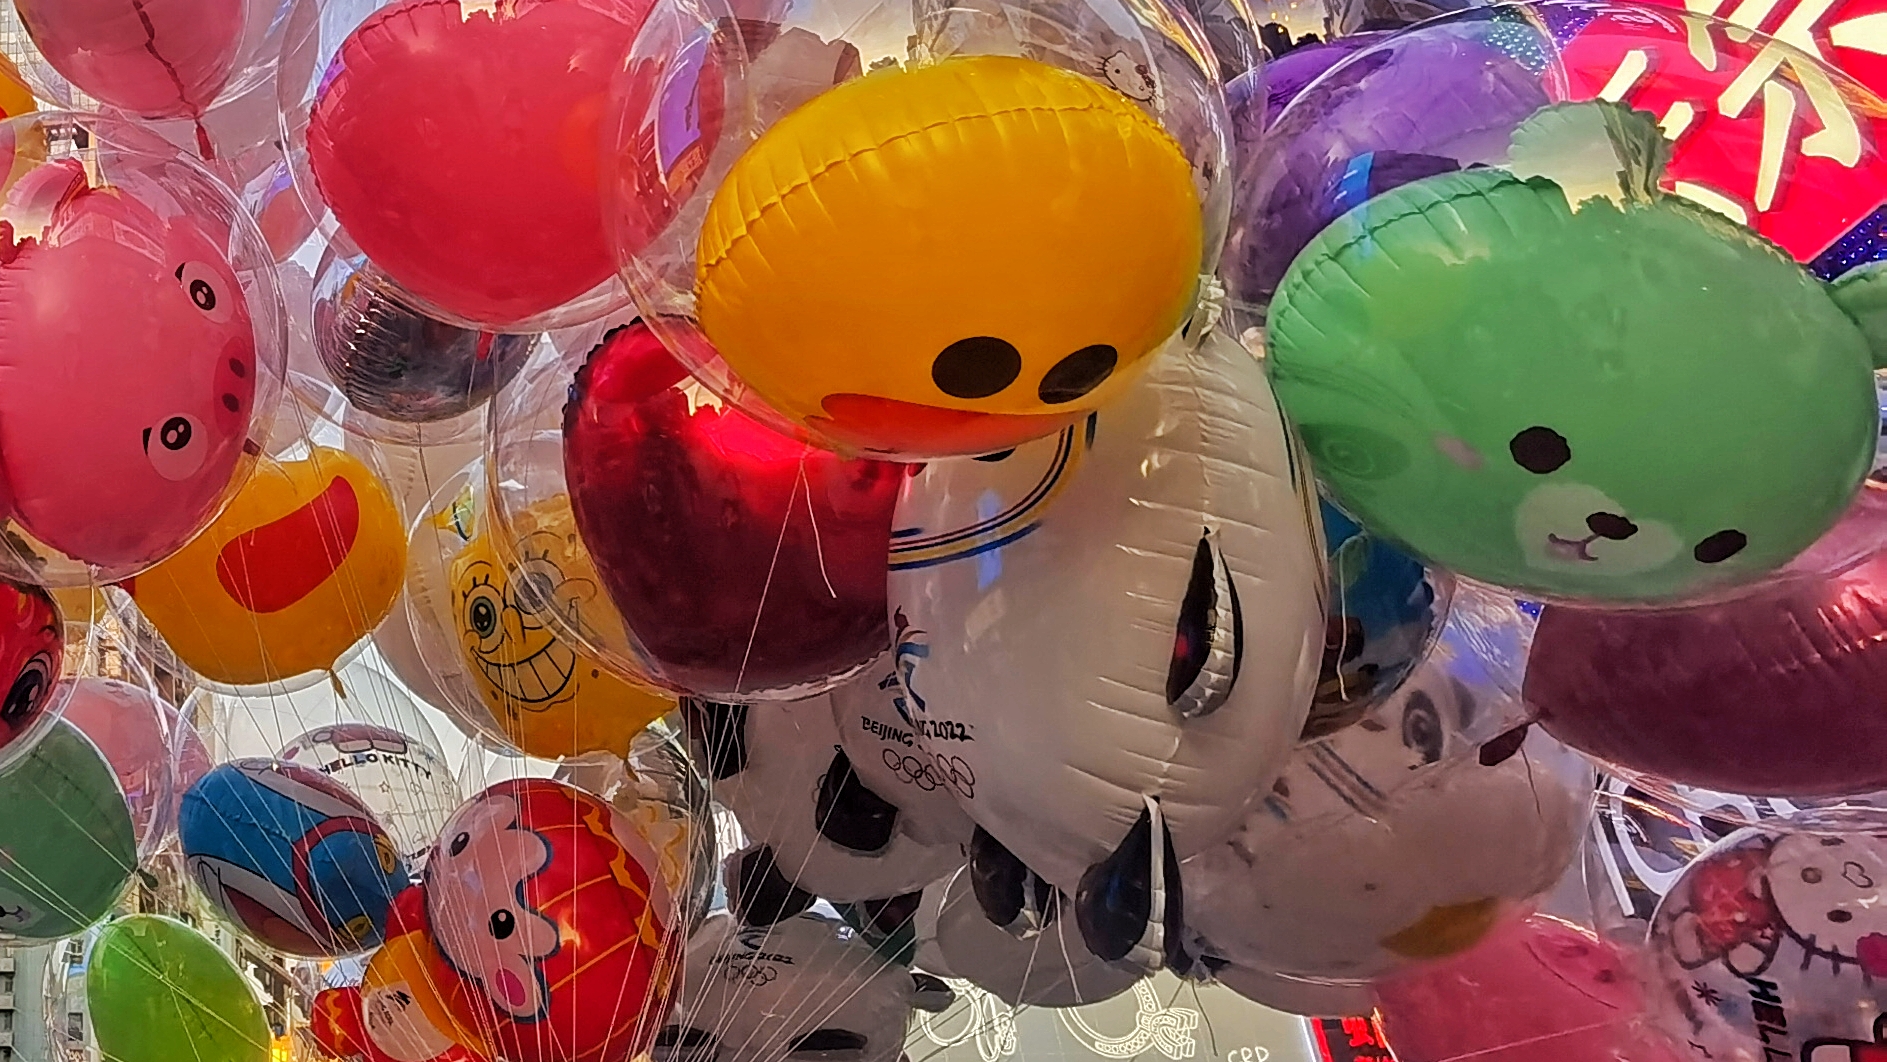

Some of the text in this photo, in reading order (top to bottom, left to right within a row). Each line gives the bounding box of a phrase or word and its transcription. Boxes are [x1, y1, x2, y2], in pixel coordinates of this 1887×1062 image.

[861, 716, 914, 747] BEIJING
[318, 753, 432, 780] HELLO KITTY
